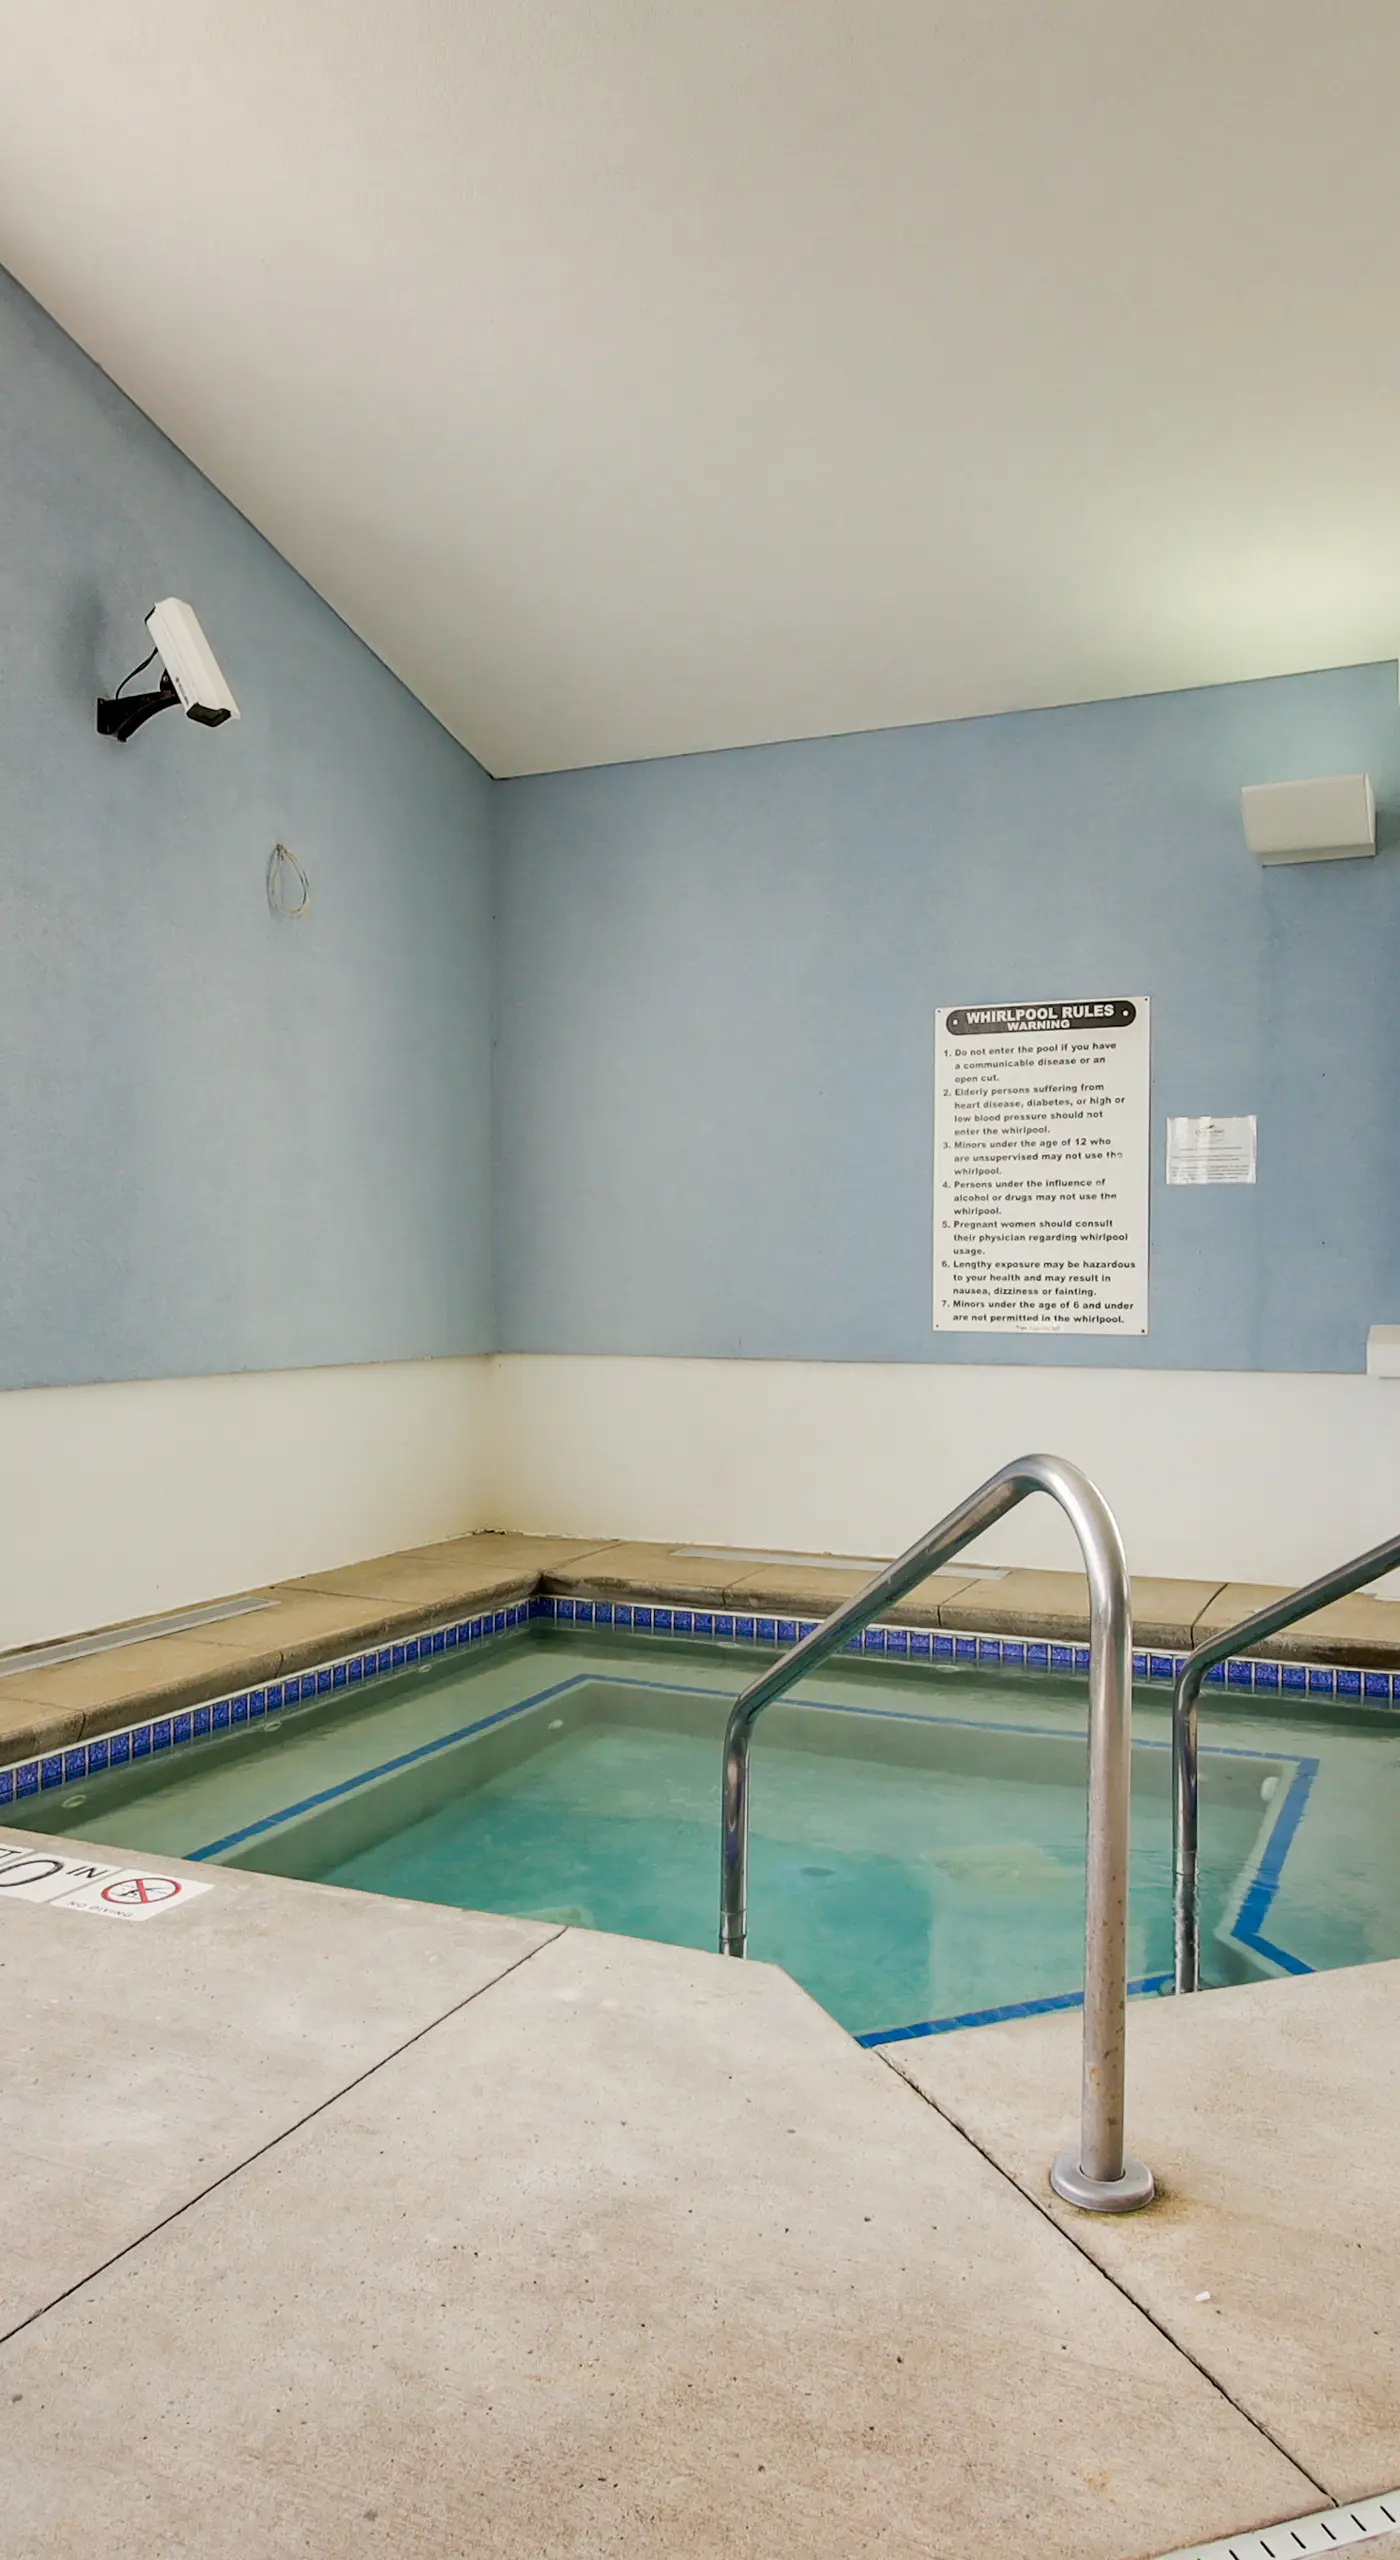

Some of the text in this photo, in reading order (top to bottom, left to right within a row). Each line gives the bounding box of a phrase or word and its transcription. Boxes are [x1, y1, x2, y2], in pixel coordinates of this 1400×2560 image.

[965, 1004, 1115, 1024] WHIRLPOOL RULES
[1007, 1019, 1071, 1032] WARNING
[944, 1042, 1117, 1057] 1. Do not enter the pool if you have
[963, 1057, 1035, 1069] communicable
[1037, 1057, 1077, 1066] disease
[1079, 1057, 1091, 1065] or
[1093, 1056, 1106, 1064] an
[955, 1074, 1000, 1084] open cut.
[943, 1083, 1105, 1097] 2. Elderly persons suffering from
[954, 1101, 981, 1110] heart
[983, 1100, 1024, 1109] disease,
[1027, 1098, 1074, 1107] diabetes,
[1089, 1096, 1112, 1106] high
[1114, 1096, 1125, 1104] or
[954, 1111, 1104, 1123] low blood pressure should not
[954, 1125, 1051, 1136] enter the whirlpool.
[943, 1142, 951, 1150] 3.
[954, 1141, 987, 1149] Minors
[989, 1140, 1018, 1148] under
[1021, 1139, 1037, 1148] the
[1039, 1139, 1058, 1149] age
[1061, 1138, 1071, 1146] of
[1075, 1138, 1087, 1146] 12
[954, 1155, 970, 1163] are
[973, 1152, 1039, 1163] unsupervised
[1041, 1153, 1063, 1161] may
[1065, 1152, 1082, 1160] not
[1106, 1151, 1123, 1159] the
[954, 1167, 1003, 1176] whirlpool.
[942, 1178, 1106, 1189] 4. Persons under the influence of
[953, 1193, 990, 1202] alcohol
[992, 1194, 1003, 1202] or
[1004, 1193, 1033, 1203] drugs
[1035, 1194, 1057, 1203] may
[1100, 1192, 1117, 1200] the
[953, 1207, 1002, 1216] whirlpool.
[942, 1220, 1113, 1230] 5. Pregnant women should consult
[953, 1233, 1128, 1243] their physician regarding whirlpool
[953, 1248, 986, 1257] usage.
[953, 1261, 993, 1270] Lengthy
[995, 1261, 1040, 1270] exposure
[1043, 1262, 1065, 1270] may
[1067, 1260, 1080, 1269] be
[1082, 1260, 1136, 1269] hazardous
[953, 1274, 1111, 1284] to your health and may result in
[953, 1287, 1097, 1297] nausea, dizziness or fainting.
[941, 1300, 1134, 1311] 7. Minors under the age of 6 and under
[990, 1314, 1039, 1323] permitted
[1041, 1314, 1051, 1323] in
[1054, 1315, 1071, 1323] the
[1073, 1315, 1124, 1324] whirlpool.
[66, 1865, 108, 1879] IN
[67, 1901, 134, 1918] NO DIVING
